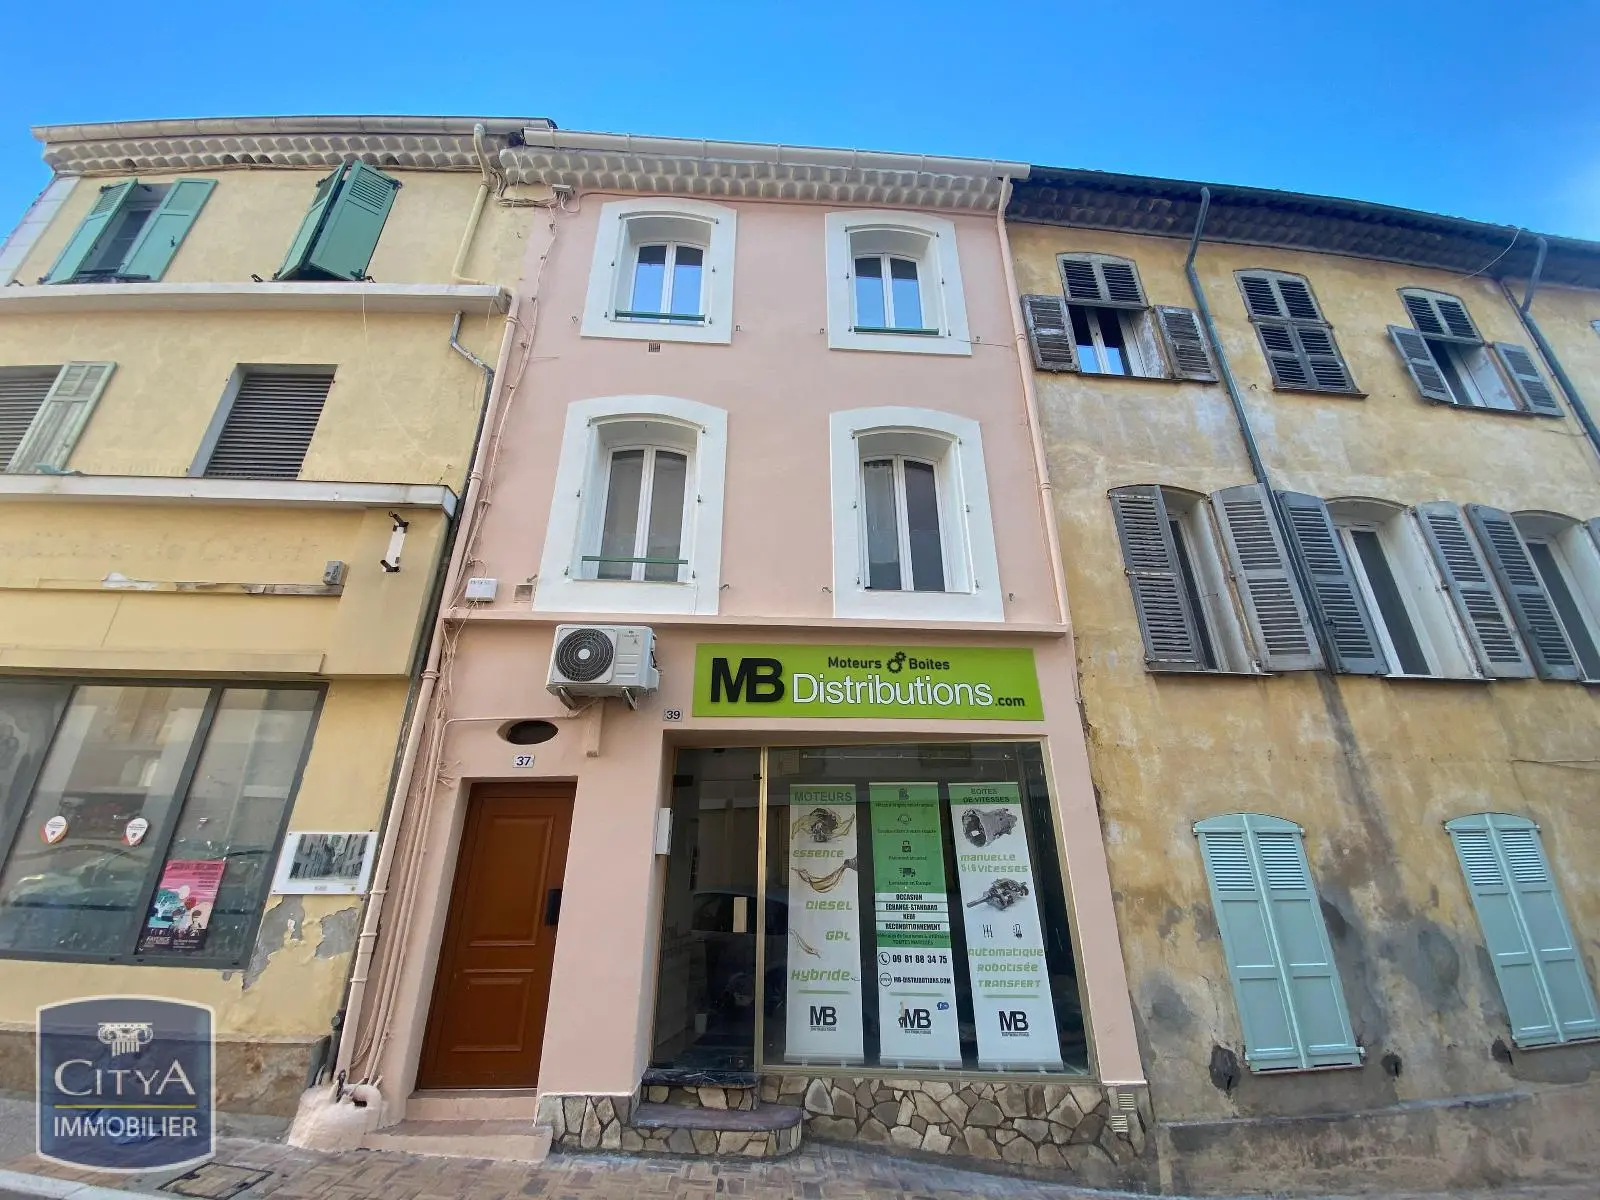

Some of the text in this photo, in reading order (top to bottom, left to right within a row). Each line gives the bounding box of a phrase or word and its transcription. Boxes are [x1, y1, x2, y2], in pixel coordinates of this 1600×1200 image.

[828, 656, 950, 670] Moteurs Boites
[710, 657, 785, 703] MB
[666, 710, 681, 720] 39
[516, 756, 531, 766] 37
[794, 791, 853, 802] MOTEURS
[895, 893, 923, 901] OCCASION
[938, 955, 948, 964] 75
[791, 969, 850, 982] Hybride
[810, 1006, 837, 1026] MB
[998, 1010, 1029, 1032] MB
